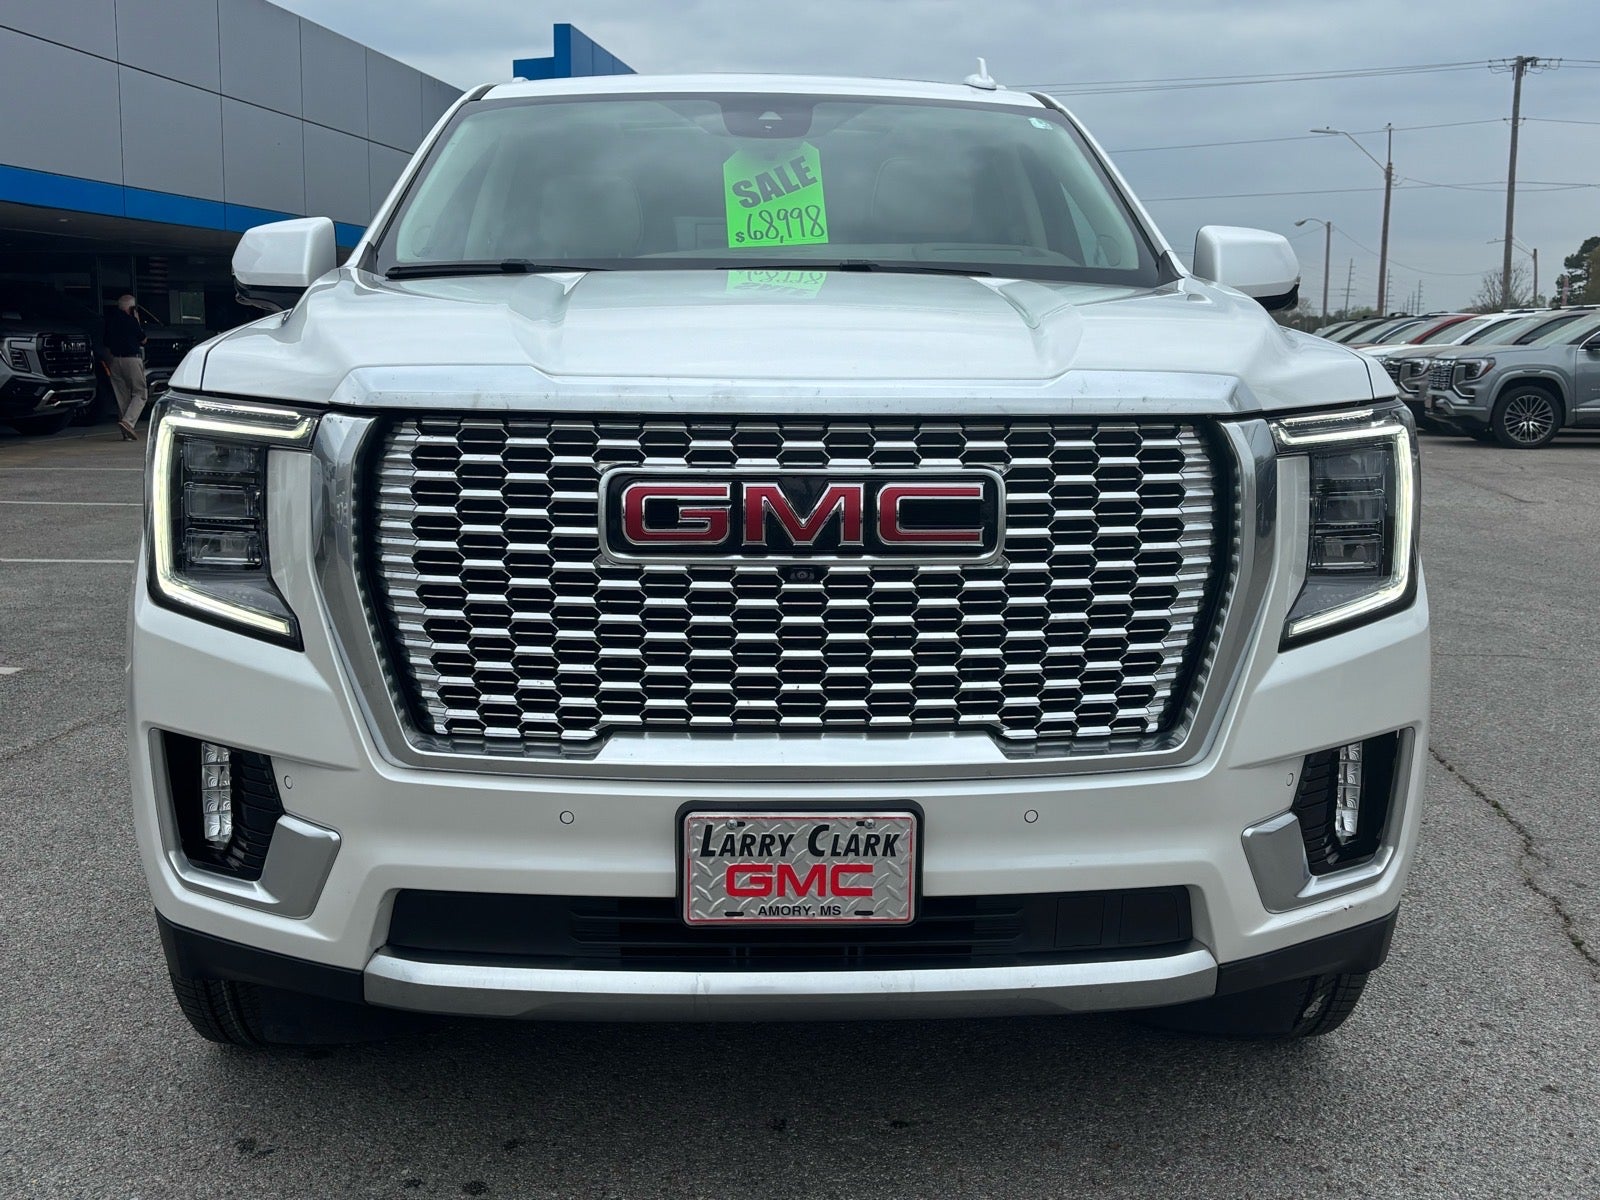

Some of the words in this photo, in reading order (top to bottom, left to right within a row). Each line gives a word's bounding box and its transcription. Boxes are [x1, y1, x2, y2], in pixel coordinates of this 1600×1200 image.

[732, 155, 818, 208] SALE
[735, 205, 825, 243] $68,998
[621, 482, 985, 547] GMC
[699, 824, 794, 857] LARRY
[807, 824, 900, 857] CLARK
[725, 863, 874, 898] GMC
[757, 905, 816, 917] AMORY,
[820, 905, 842, 916] MS
